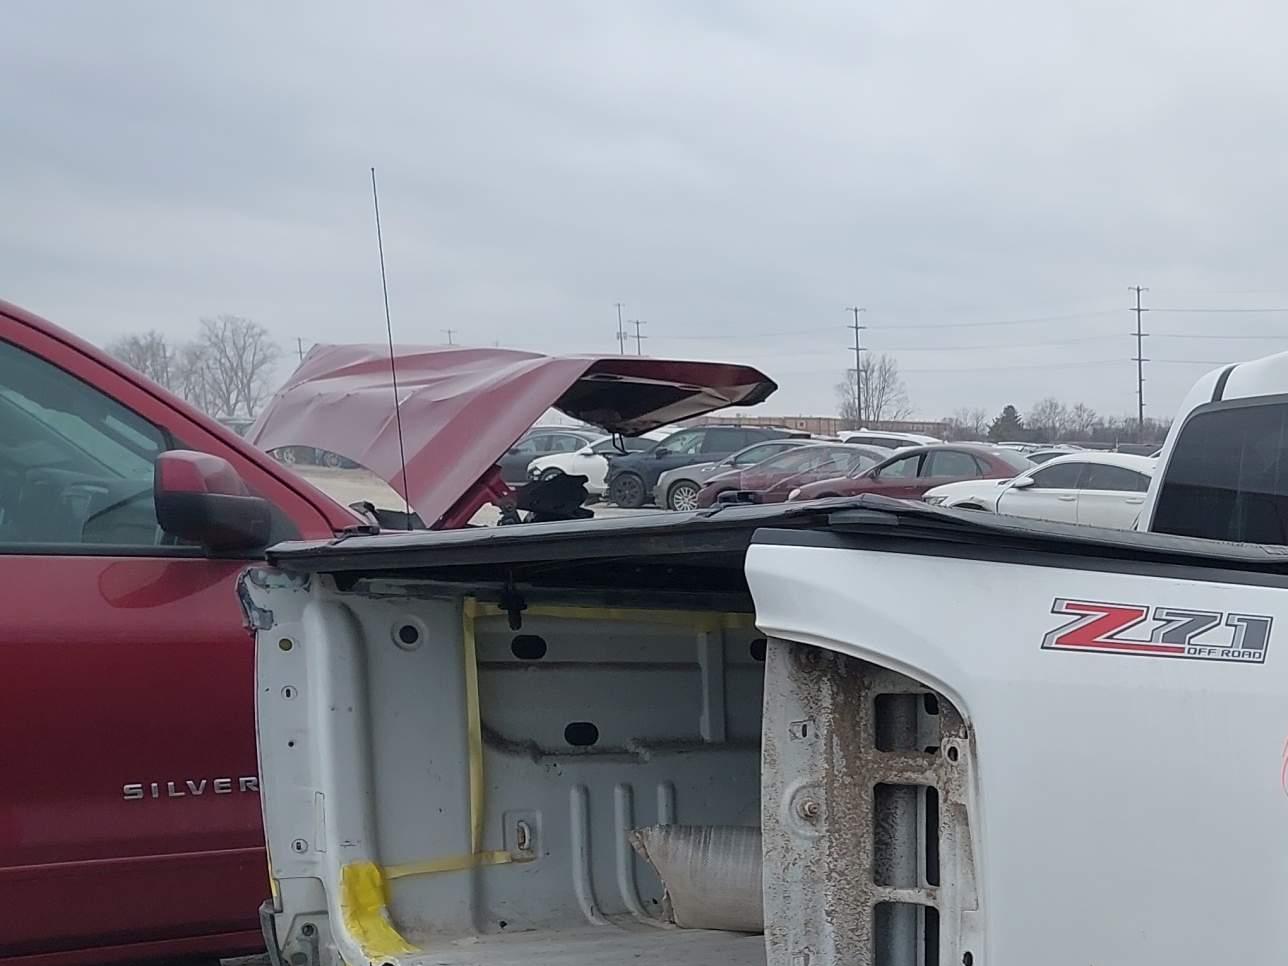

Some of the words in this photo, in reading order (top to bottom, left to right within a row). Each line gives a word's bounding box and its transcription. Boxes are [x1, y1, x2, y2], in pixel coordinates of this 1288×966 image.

[1041, 597, 1273, 663] Z71
[1187, 647, 1217, 656] OFF
[1220, 649, 1262, 659] ROAD
